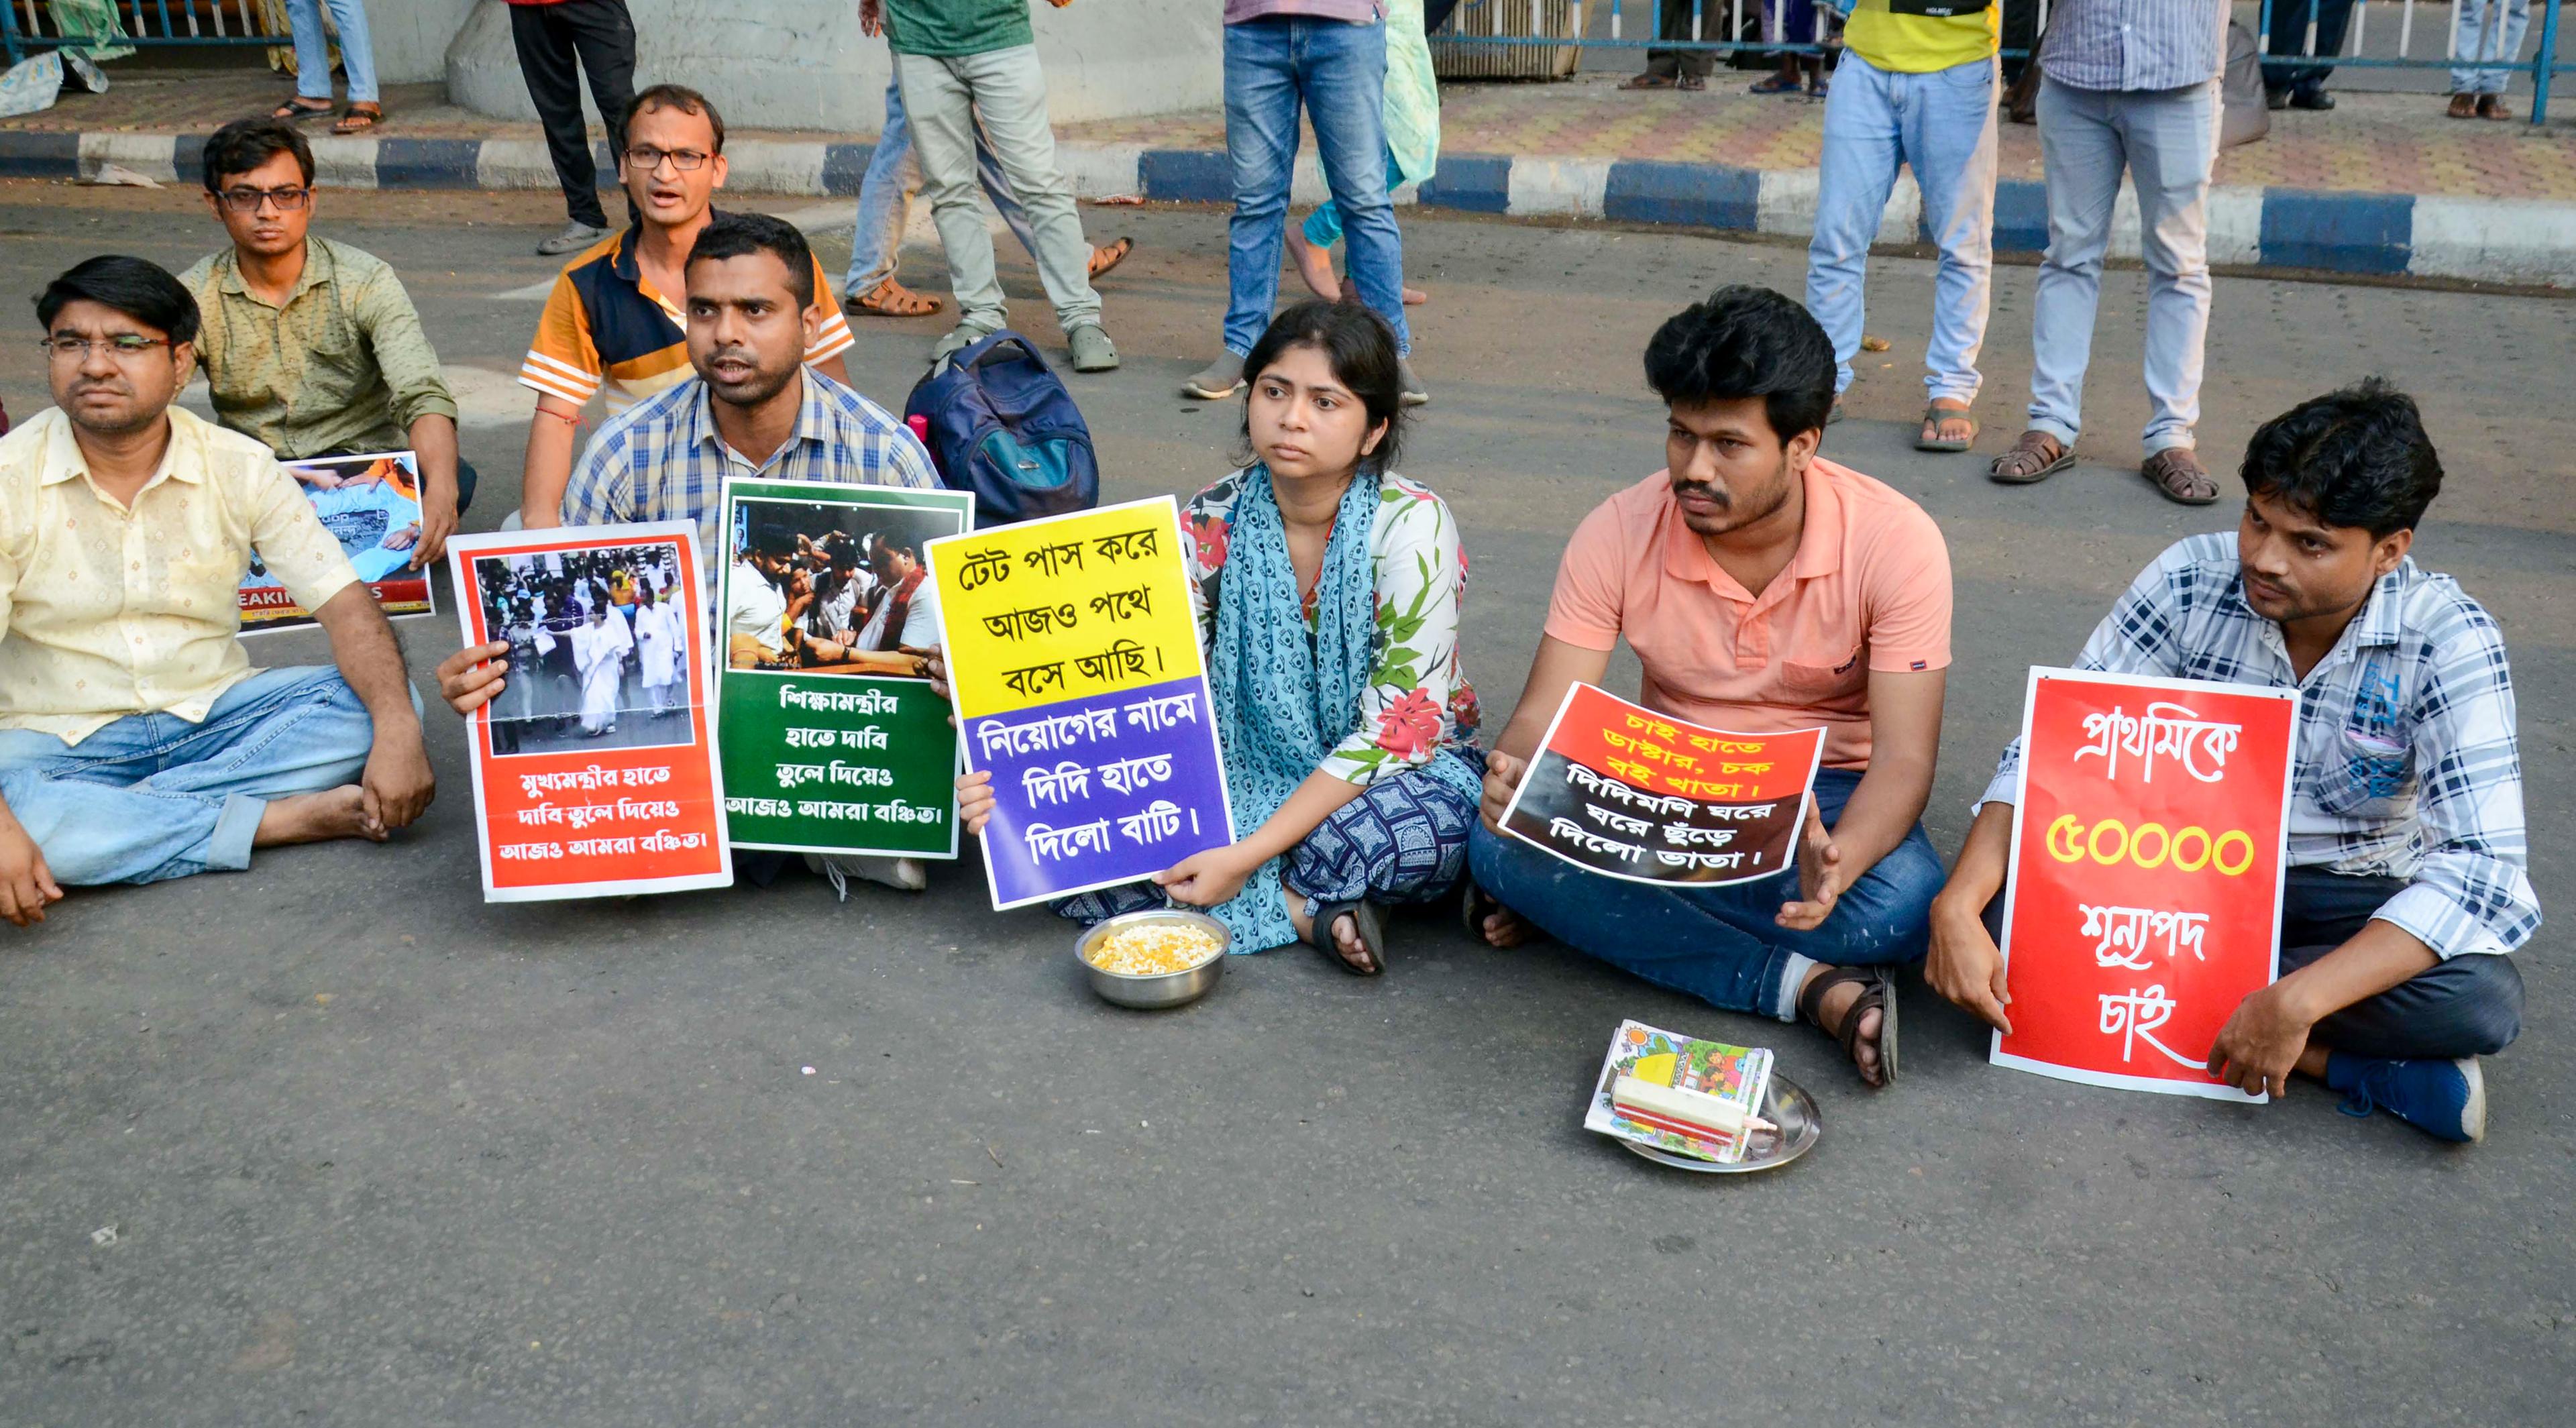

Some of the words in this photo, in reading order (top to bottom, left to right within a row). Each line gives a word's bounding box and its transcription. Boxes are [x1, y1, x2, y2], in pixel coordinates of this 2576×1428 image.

[959, 547, 1011, 591] টেট
[1024, 543, 1083, 575] পাস
[1093, 529, 1157, 562] করে
[983, 603, 1077, 641] আজও
[1090, 584, 1151, 622] পথে
[780, 684, 898, 715] শিক্ষামন্ত্রীর
[1002, 662, 1064, 696] বসে
[786, 728, 837, 747] হাতে
[841, 726, 888, 749] দাবি
[977, 706, 1117, 761] নিয়োগের
[1124, 692, 1197, 732] নামে
[1626, 714, 1681, 743] চাই
[1689, 734, 1765, 753] হাতে
[2074, 702, 2243, 784] প্রাথমিকে
[520, 765, 618, 798] মুখ্যমন্ত্রীর
[621, 766, 670, 787] হাতে
[776, 764, 825, 787] তুলে
[829, 760, 893, 786] দিয়েও
[1022, 761, 1090, 808] দিদি
[1097, 753, 1172, 795] হাতে
[1608, 756, 1657, 785] বই
[1721, 762, 1774, 775] চক
[517, 802, 562, 826] দাবি
[568, 805, 612, 829] তুলে
[619, 797, 680, 820] দিয়েও
[725, 798, 792, 818] আজও
[798, 801, 869, 820] আমরা
[873, 800, 941, 823] বঞ্চিত।
[1566, 763, 1699, 819] দিদিমণি
[1707, 804, 1776, 820] ঘরে
[499, 842, 564, 860] আজও
[567, 836, 635, 855] আমরা
[639, 829, 706, 852] বঞ্চিত।
[1024, 817, 1111, 865] দিলো
[1550, 817, 1648, 864] দিলো
[1586, 802, 1654, 838] ঘরে
[1662, 822, 1737, 846] ছুঁড়ে
[2046, 814, 2254, 876] ৫০০০০
[2079, 903, 2210, 971] শূন্যপদ
[2098, 984, 2207, 1069] চাই
